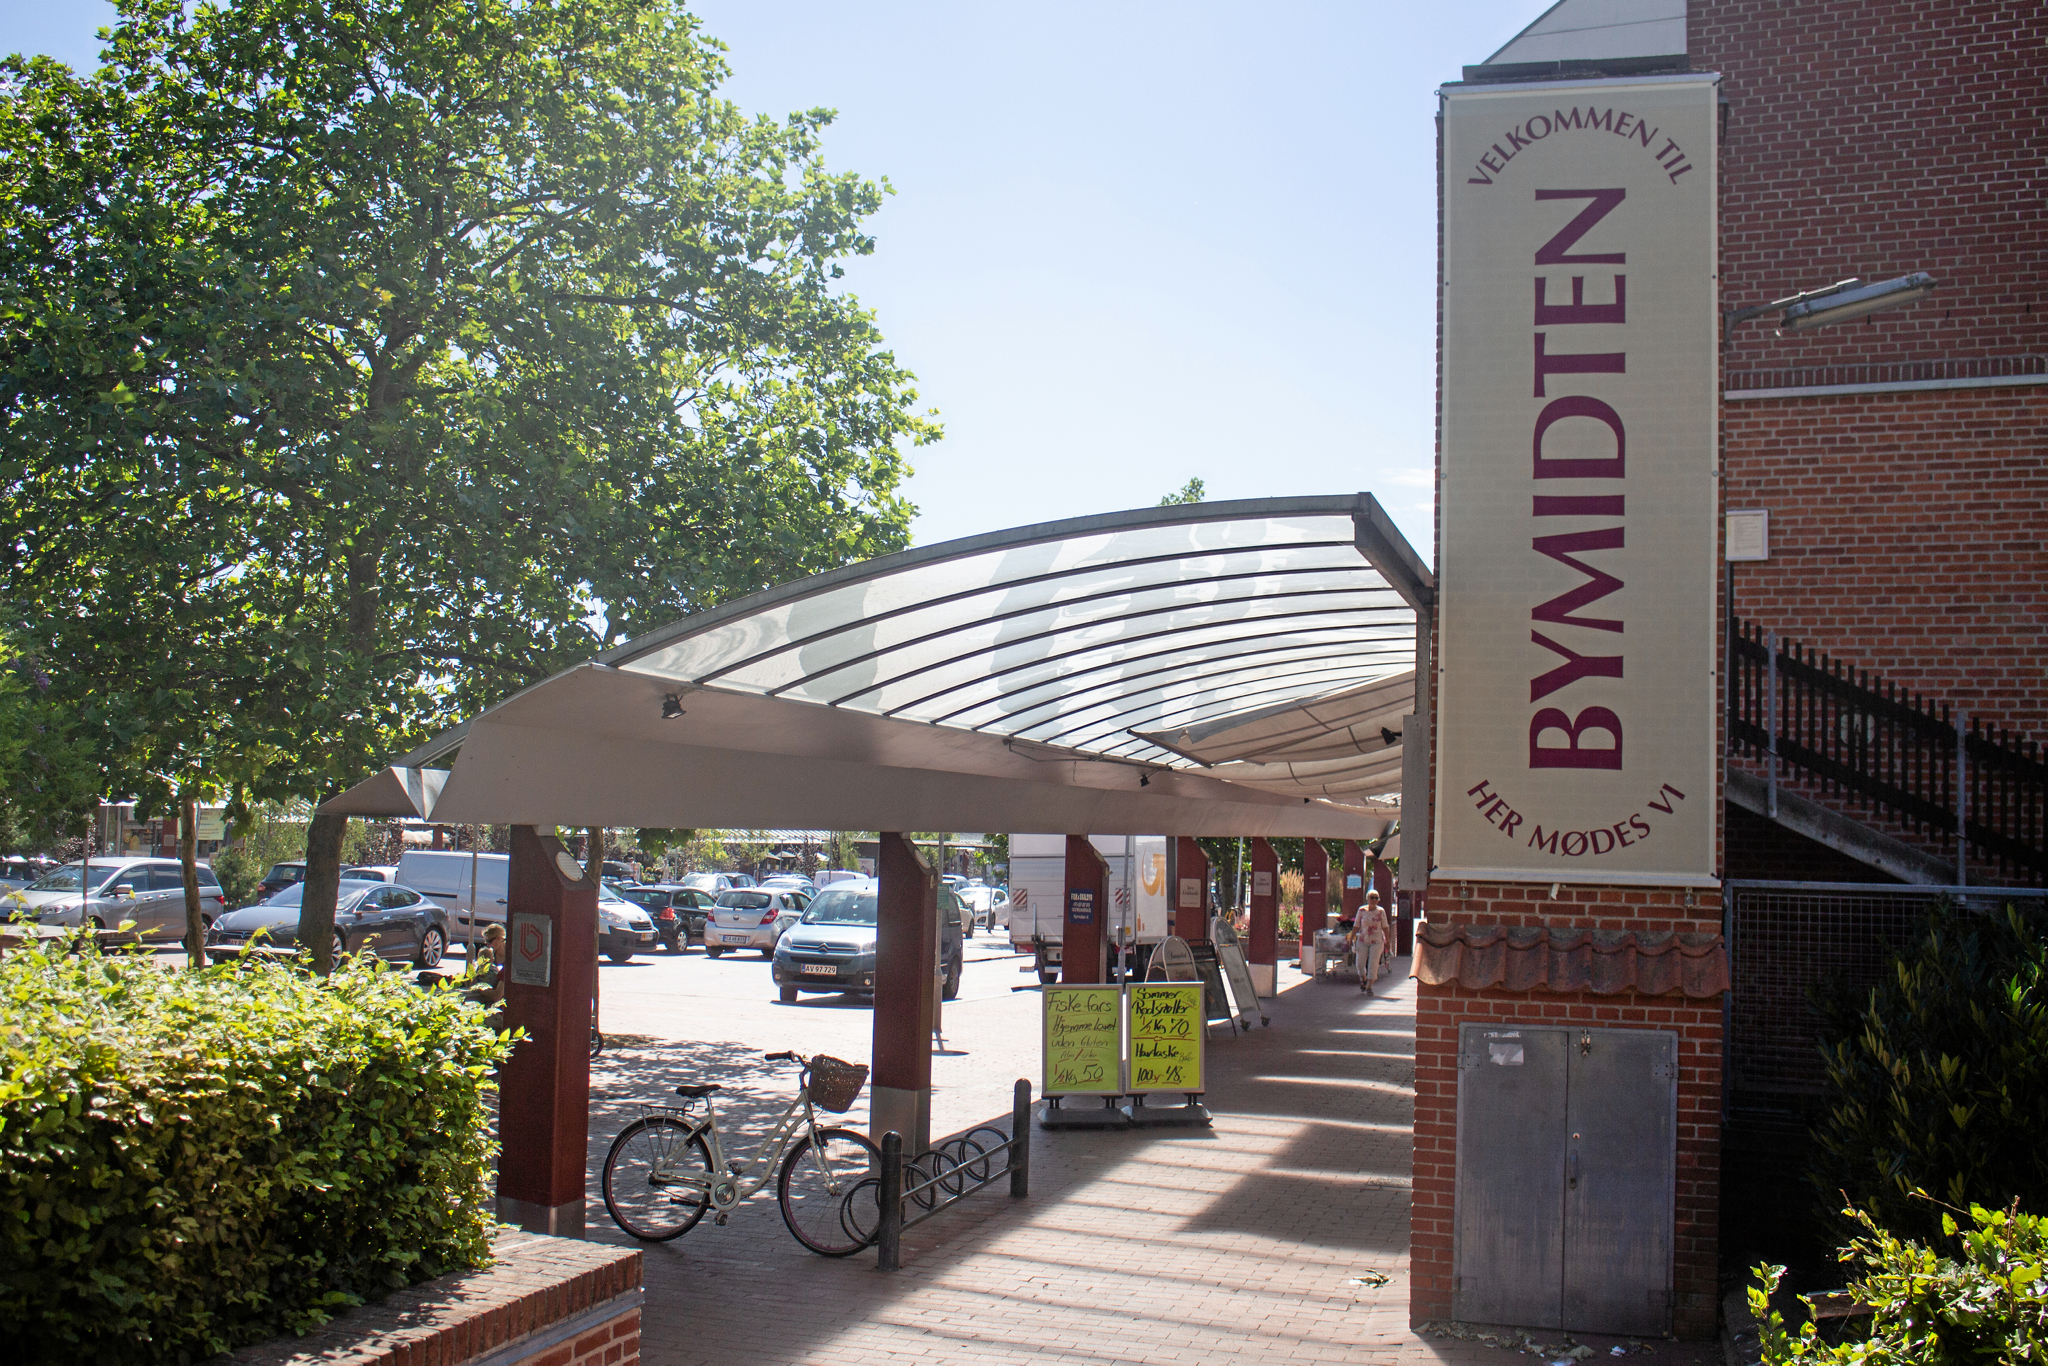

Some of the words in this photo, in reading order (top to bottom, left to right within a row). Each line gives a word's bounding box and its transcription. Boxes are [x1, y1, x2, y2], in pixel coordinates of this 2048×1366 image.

[1467, 106, 1659, 185] VELKOMMEN
[1655, 137, 1693, 185] TIL
[1529, 187, 1626, 770] BYMIDTEN
[1467, 779, 1523, 839] HER
[1528, 813, 1651, 857] MØDES
[1647, 783, 1686, 815] VI
[824, 966, 836, 974] 729
[1136, 987, 1183, 999] Sommer
[1169, 1018, 1190, 1036] 70
[1082, 1063, 1104, 1081] 50
